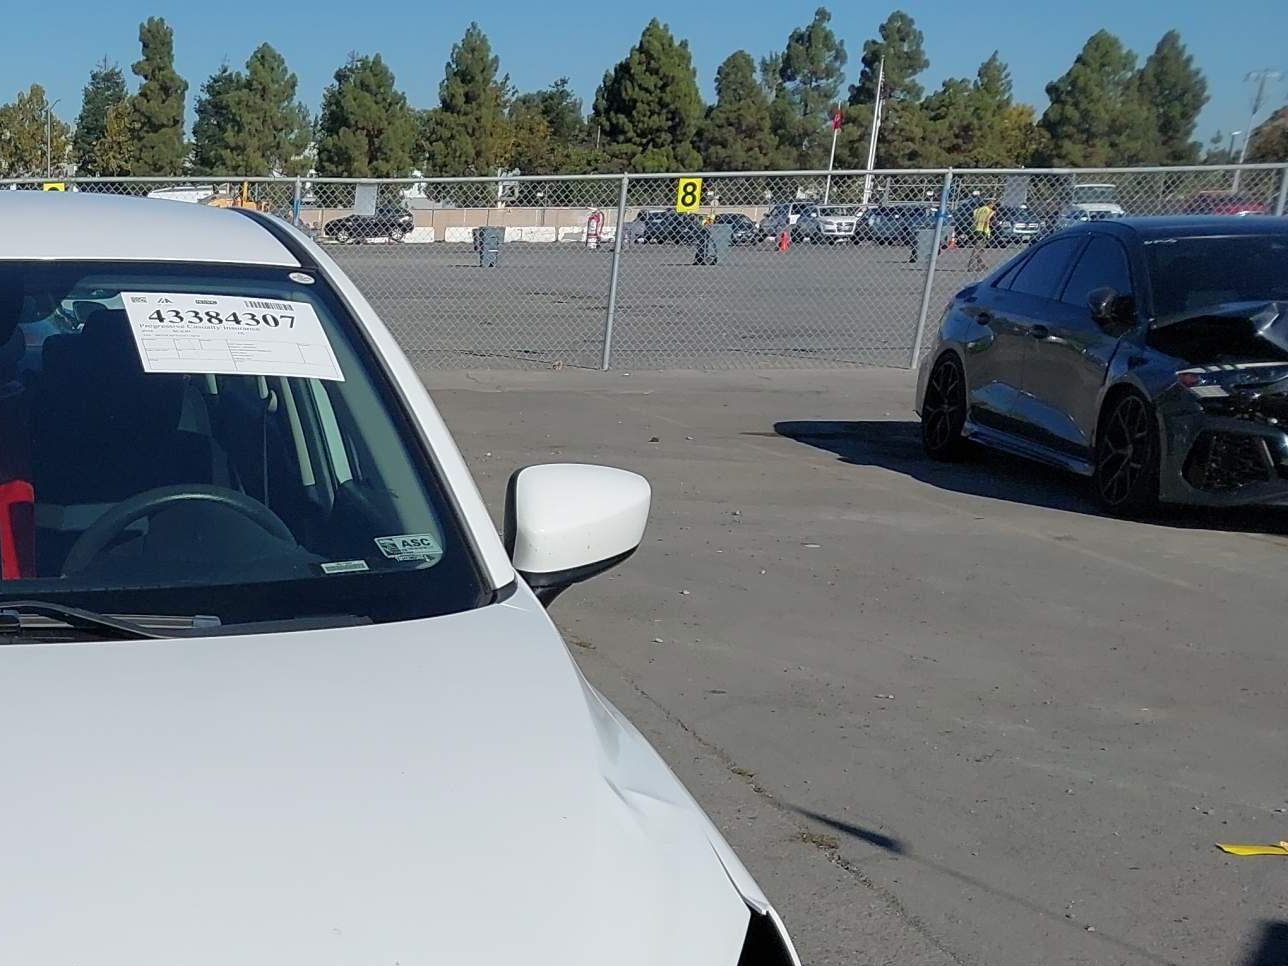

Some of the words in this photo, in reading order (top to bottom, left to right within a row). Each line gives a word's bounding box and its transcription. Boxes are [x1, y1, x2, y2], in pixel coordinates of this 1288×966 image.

[681, 182, 697, 207] 8
[148, 309, 295, 329] 43384307
[401, 538, 431, 548] ASC
